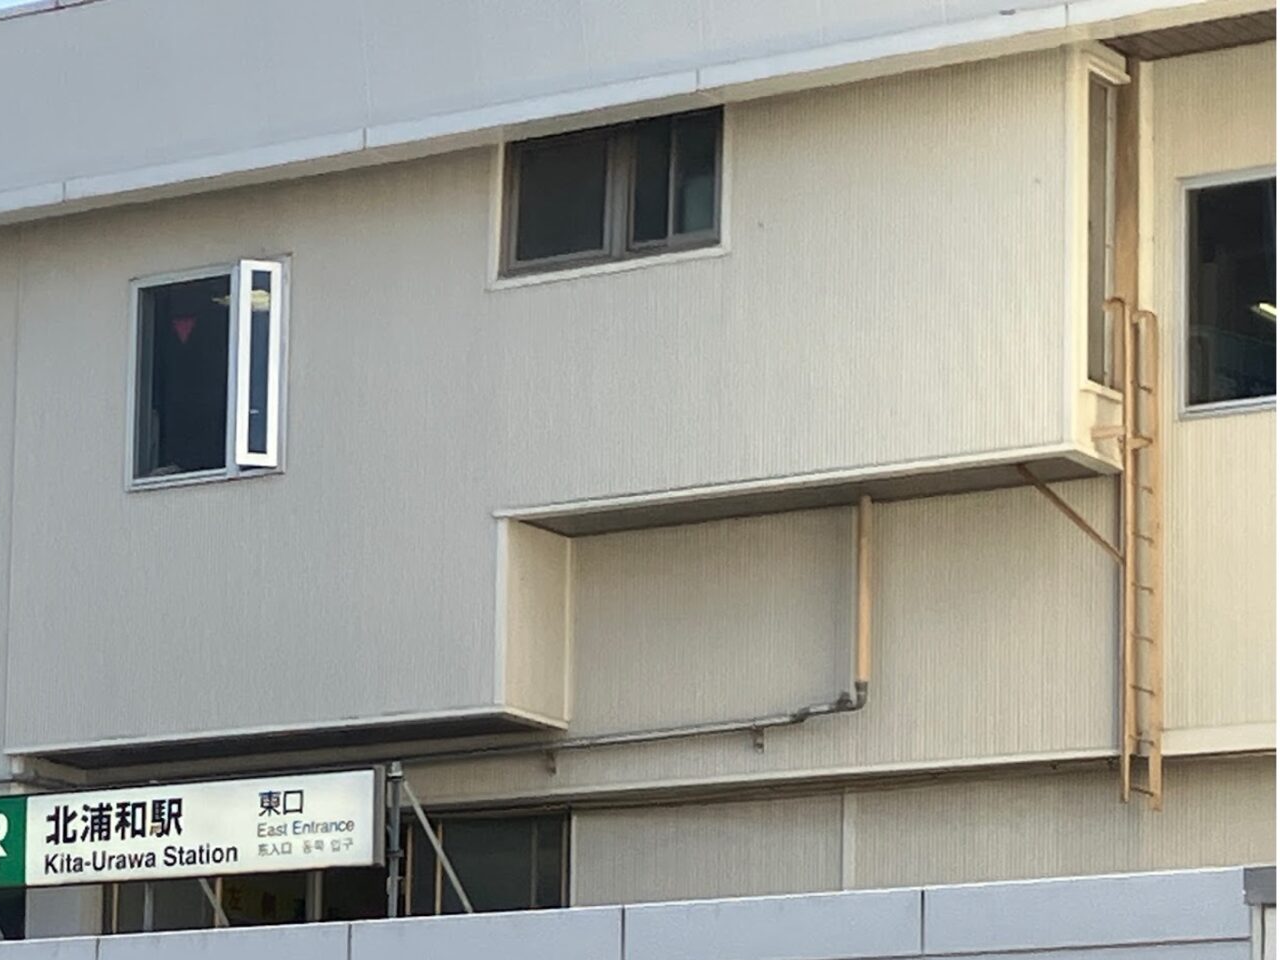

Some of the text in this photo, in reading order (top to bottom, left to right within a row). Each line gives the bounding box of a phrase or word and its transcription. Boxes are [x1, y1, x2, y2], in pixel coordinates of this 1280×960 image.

[258, 789, 304, 816] 東口
[46, 798, 183, 845] 北浦和駅
[257, 820, 355, 838] East Entrance
[44, 843, 238, 875] Kita-Urawa Station
